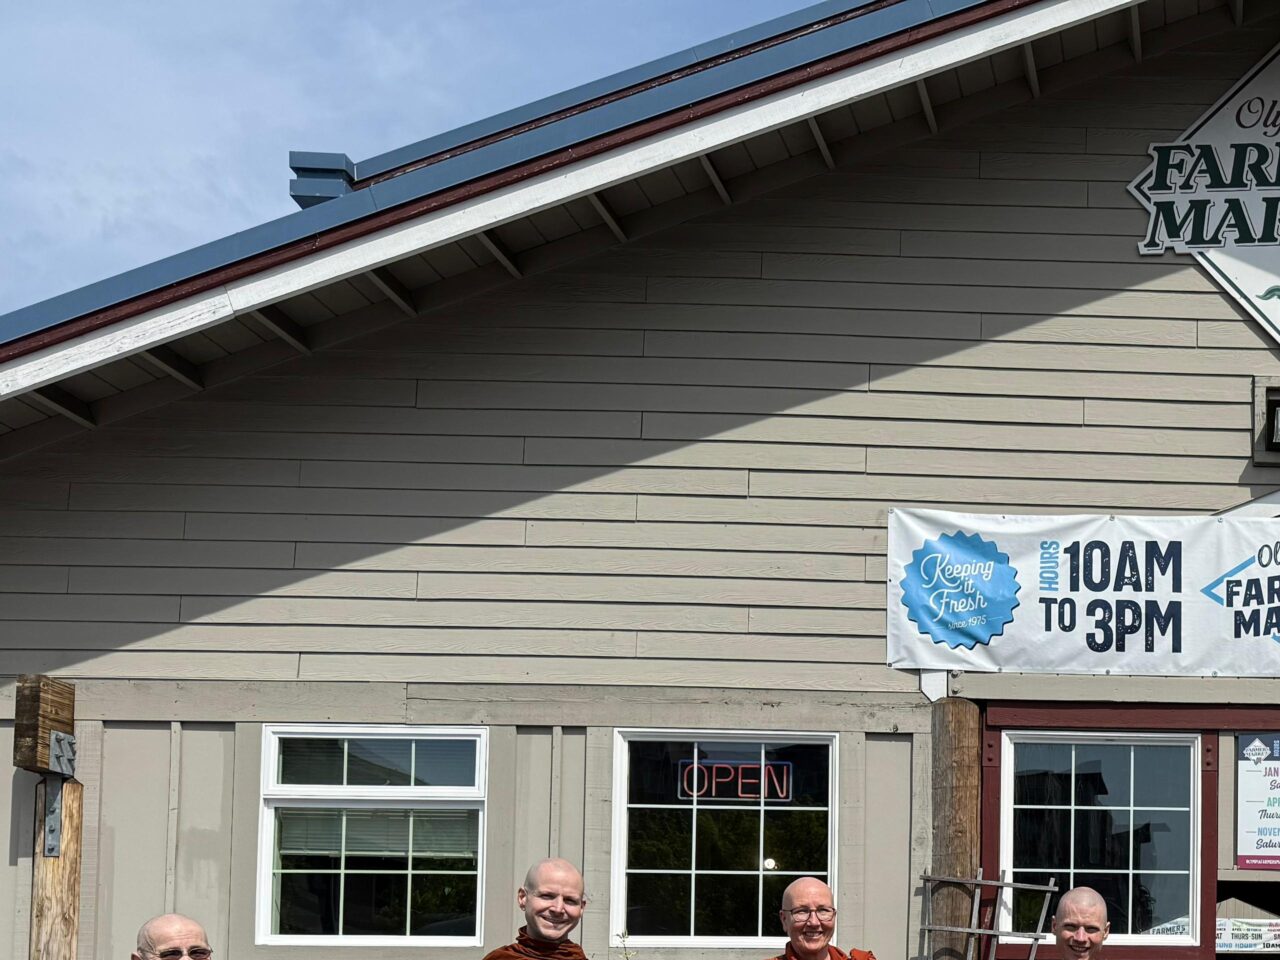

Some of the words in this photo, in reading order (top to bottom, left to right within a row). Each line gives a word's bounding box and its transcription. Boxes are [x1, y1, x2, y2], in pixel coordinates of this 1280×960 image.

[920, 553, 994, 588] Keeping
[1039, 540, 1060, 592] HOURS
[1064, 540, 1182, 593] 10AM
[929, 585, 988, 622] Fresh
[963, 577, 975, 594] it
[948, 621, 966, 630] since
[968, 615, 987, 626] 1975
[1039, 597, 1076, 632] TO
[1086, 599, 1182, 653] 3PM
[683, 764, 787, 798] OPEN
